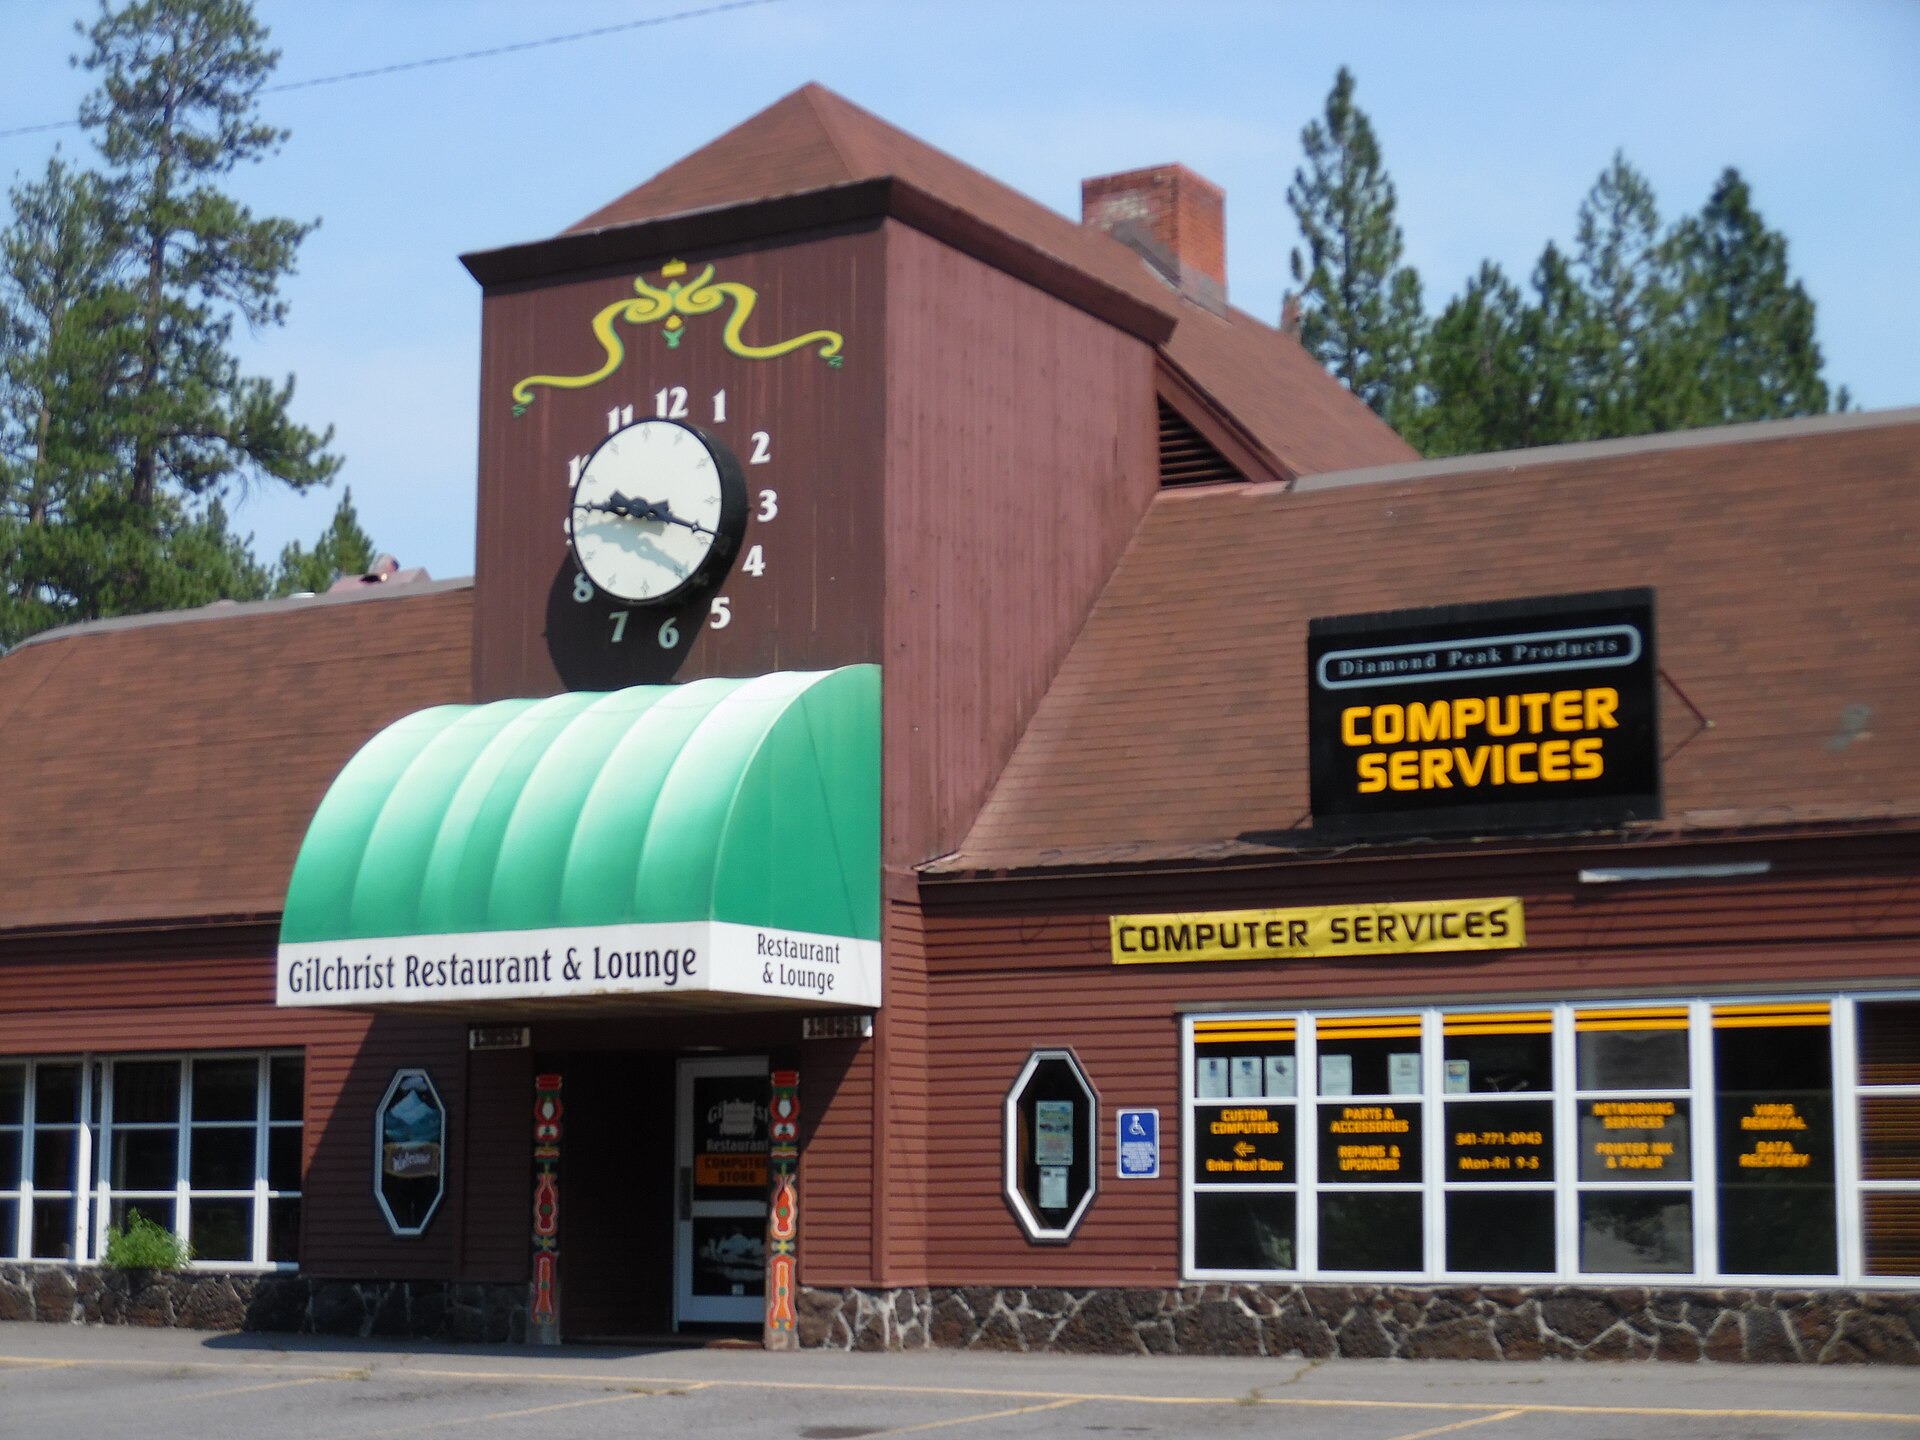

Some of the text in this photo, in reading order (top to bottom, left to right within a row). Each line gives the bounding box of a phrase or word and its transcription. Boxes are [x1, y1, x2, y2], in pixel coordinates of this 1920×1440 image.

[607, 404, 633, 434] 11
[655, 386, 688, 420] 12
[713, 389, 726, 423] 1
[751, 431, 771, 465] 2
[568, 453, 590, 488] 1
[757, 489, 778, 523] 3
[742, 544, 766, 577] 4
[573, 571, 594, 603] 8
[609, 611, 629, 643] 7
[710, 596, 731, 630] 5
[658, 617, 680, 649] 6
[1339, 638, 1618, 677] Diamond Peak Products
[1341, 687, 1619, 747] COMPUTER
[1357, 737, 1604, 793] SERVICES
[1118, 909, 1510, 953] COMPUTER SERVICES
[757, 933, 841, 965] Restaurant
[289, 945, 697, 993] Gilchrist Restaurant & Lounge
[762, 962, 835, 995] & Lounge
[1221, 1108, 1268, 1121] CUSTOM
[1343, 1107, 1395, 1120] PARTS &
[1741, 1115, 1807, 1130] REMOVAL
[1753, 1103, 1795, 1115] VIRUS
[1210, 1121, 1279, 1134] COMPUTERS
[1331, 1120, 1409, 1133] ACCESSORIES
[1338, 1145, 1401, 1158] REPAIRS &
[1459, 1156, 1540, 1169] Mon-Fri 9-5
[1595, 1142, 1649, 1155] PRINTER
[1619, 1155, 1664, 1169] PAPER
[1739, 1153, 1810, 1168] RECOVERY
[1755, 1141, 1795, 1153] DATA
[718, 1171, 756, 1183] STORE
[1206, 1159, 1284, 1172] Enter Next Door
[1340, 1158, 1400, 1171] UPGRADES
